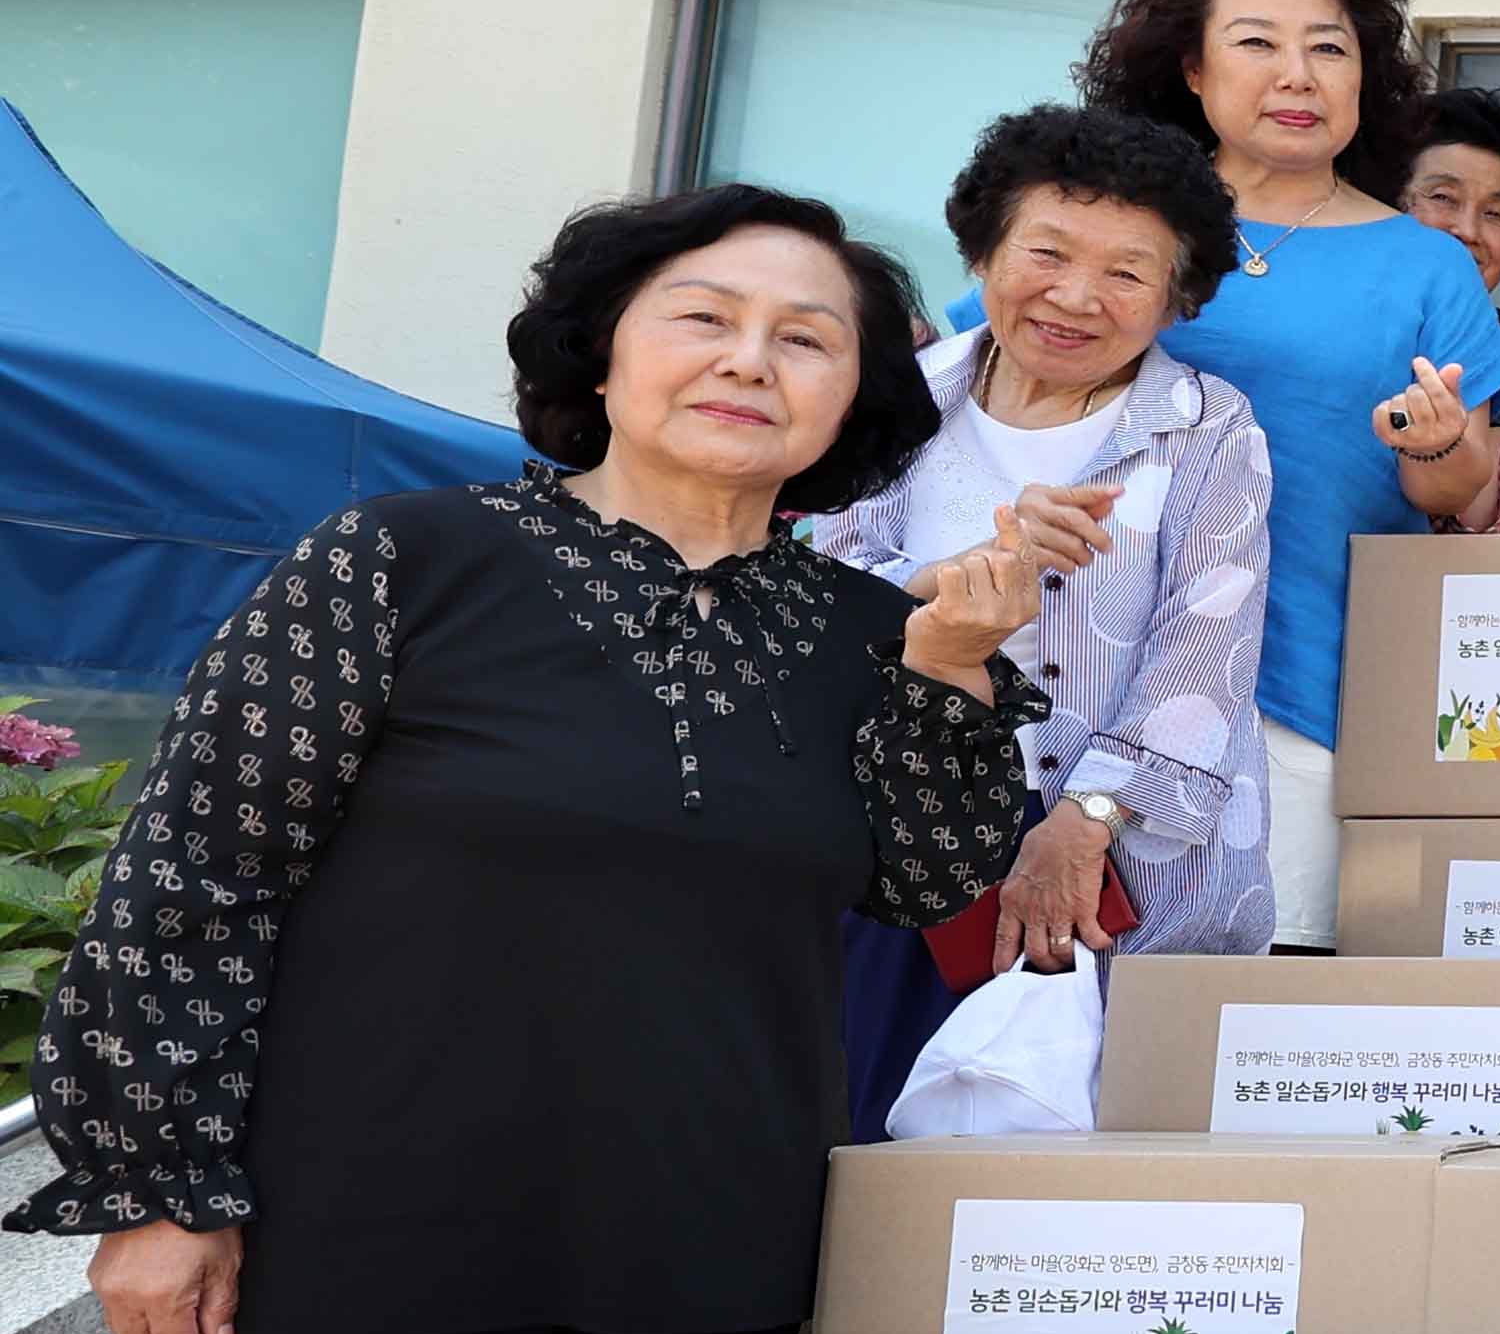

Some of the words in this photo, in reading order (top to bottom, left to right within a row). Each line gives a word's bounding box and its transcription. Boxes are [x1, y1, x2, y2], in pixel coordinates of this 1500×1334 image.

[1457, 640, 1489, 659] 농촌
[1233, 1081, 1271, 1102] 농촌
[1275, 1081, 1367, 1102] 일손돕기와
[1371, 1082, 1408, 1103] 행복
[1412, 1082, 1468, 1103] 꾸러미
[971, 1254, 1027, 1274] 함께하는
[1166, 1256, 1208, 1274] 금창동
[1212, 1256, 1284, 1274] 주민자치회
[969, 1289, 1011, 1313] 농촌
[1017, 1289, 1121, 1314] 일손돕기와
[1126, 1290, 1168, 1315] 행복
[1173, 1290, 1237, 1314] 꾸러미
[1241, 1291, 1284, 1315] 나눔
